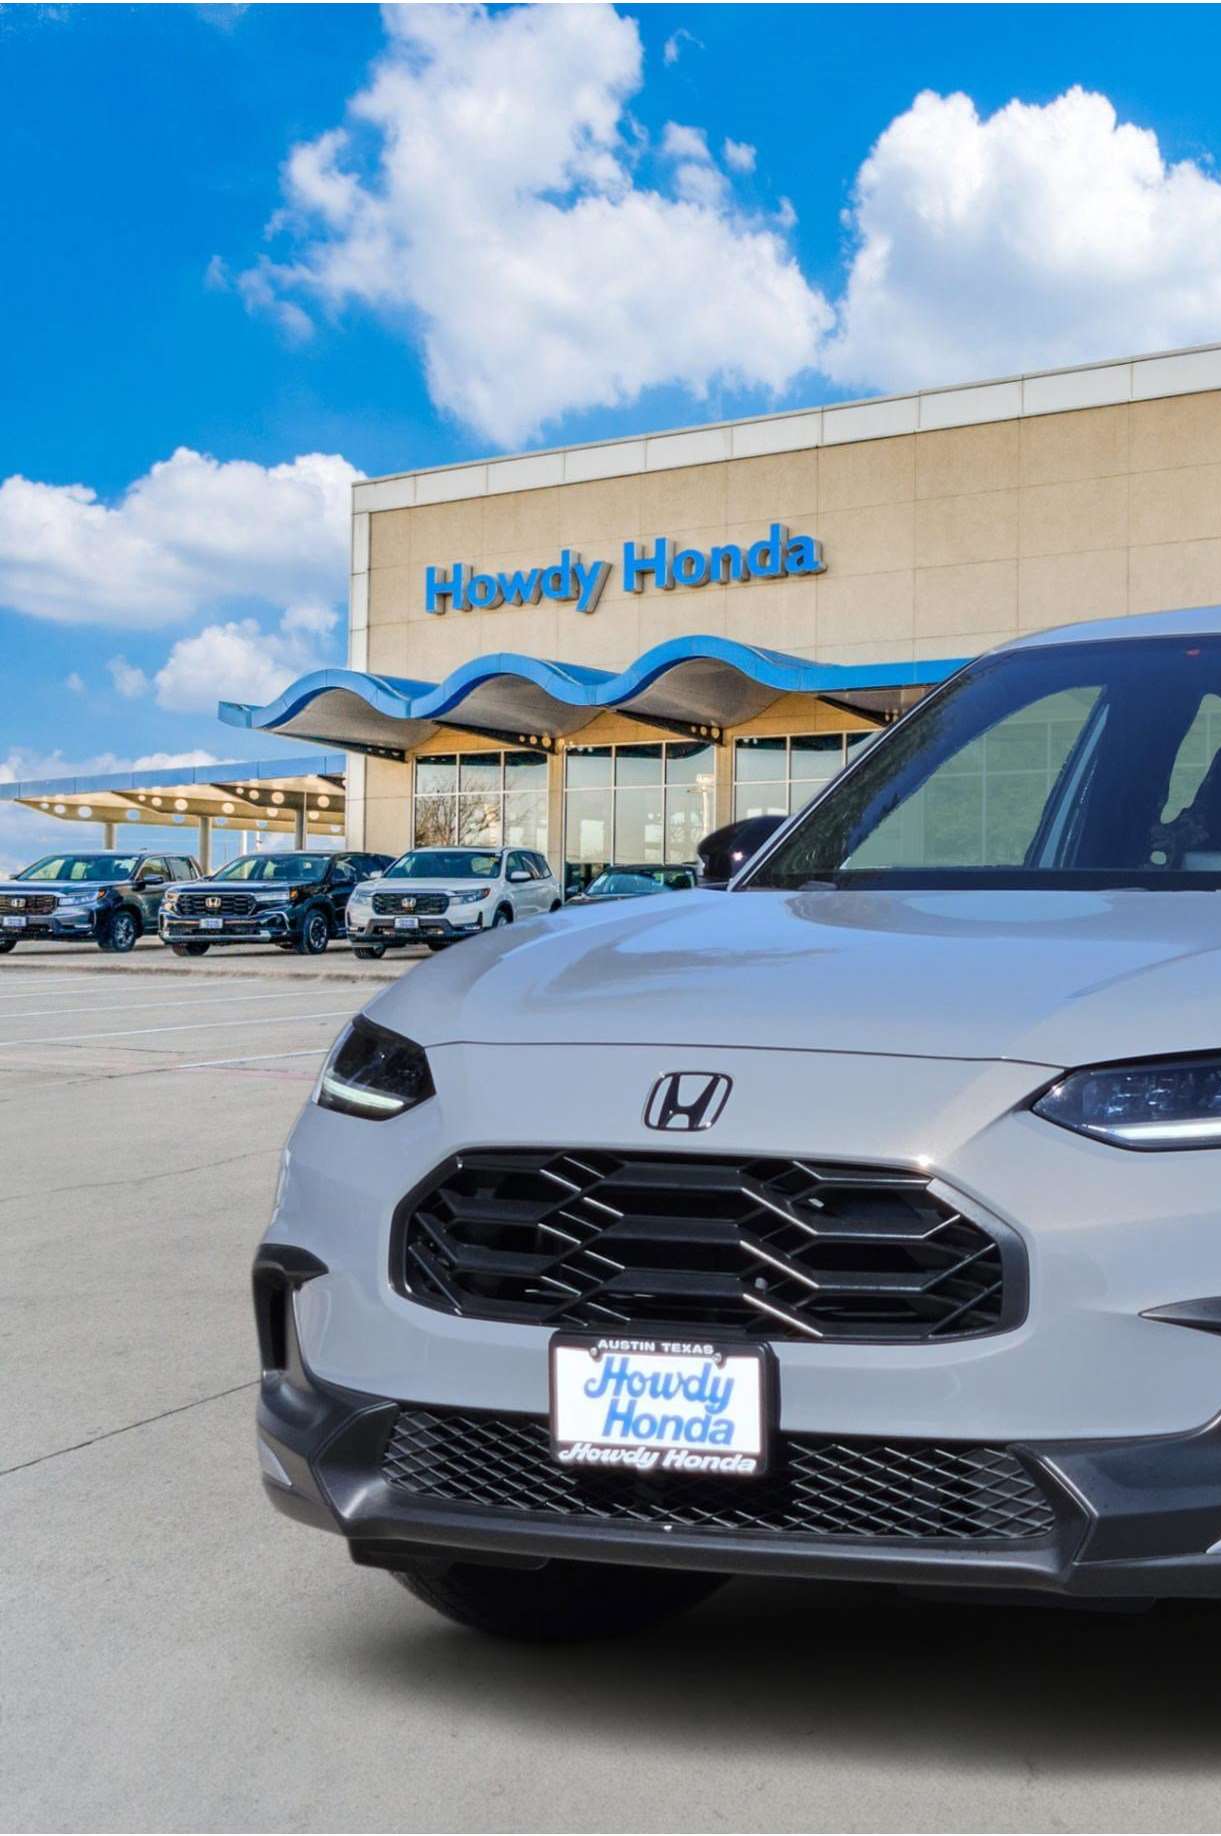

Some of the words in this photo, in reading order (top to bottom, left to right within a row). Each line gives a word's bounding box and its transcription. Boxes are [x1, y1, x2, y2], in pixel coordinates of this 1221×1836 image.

[425, 549, 612, 615] Howdy
[623, 523, 826, 593] Honda
[598, 1339, 655, 1352] AUSTIN
[661, 1342, 715, 1355] TEXAS
[584, 1356, 735, 1414] Howdy
[601, 1399, 735, 1446] Honda
[558, 1442, 660, 1469] Howdy
[662, 1446, 757, 1473] Honda
